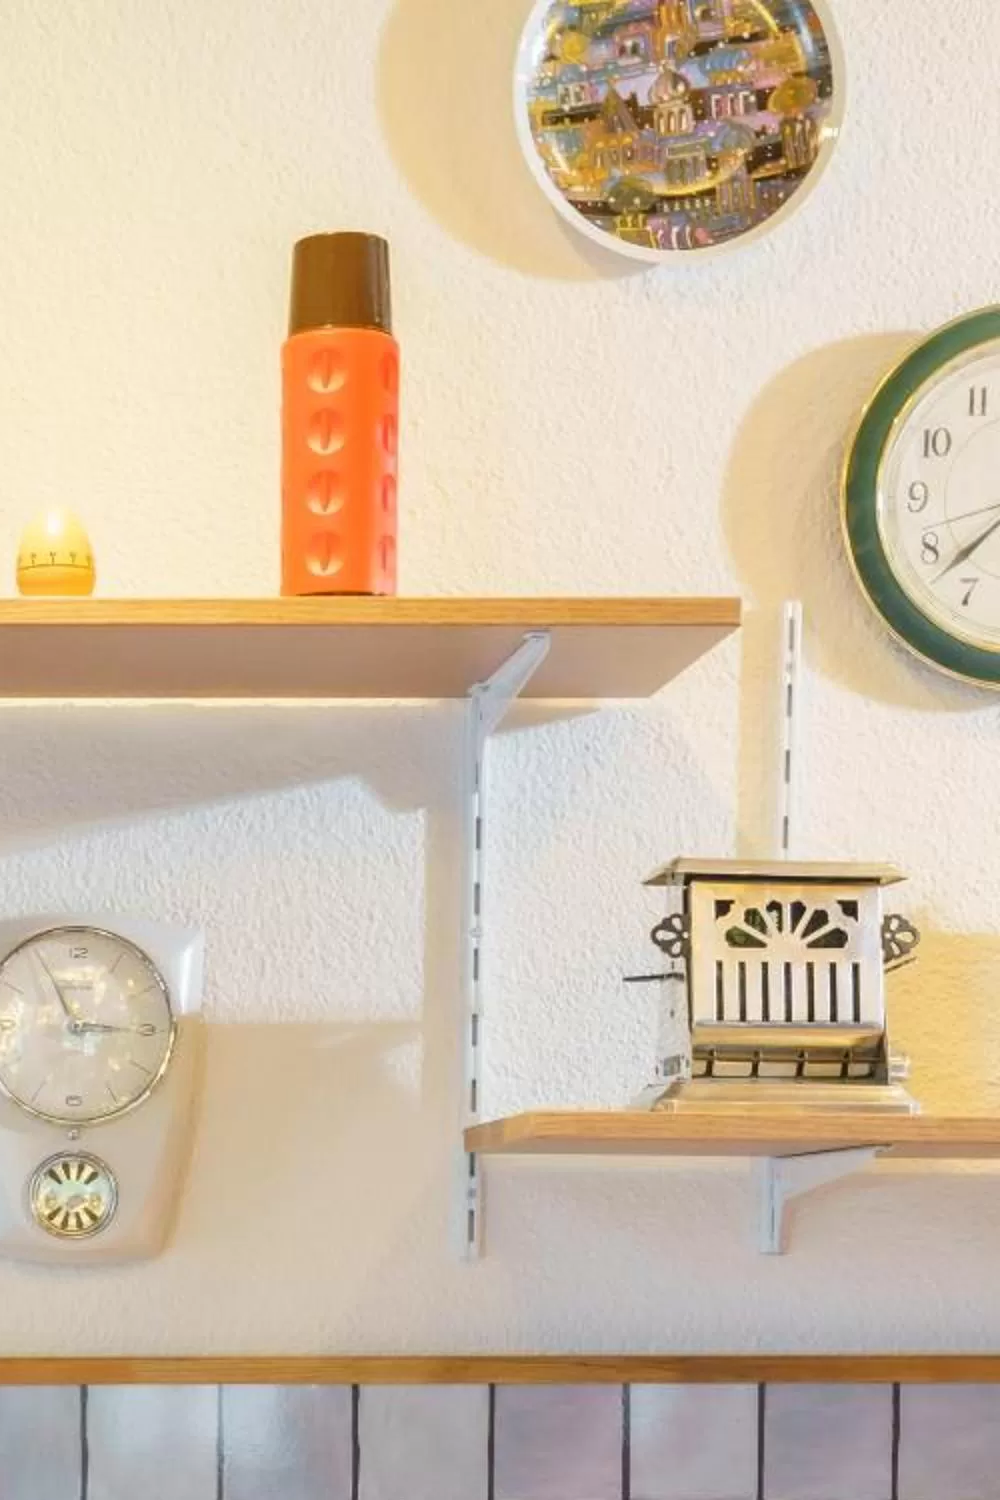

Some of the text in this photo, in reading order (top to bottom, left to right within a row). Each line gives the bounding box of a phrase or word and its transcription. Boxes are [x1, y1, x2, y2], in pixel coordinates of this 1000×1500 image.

[969, 387, 987, 416] 11
[923, 427, 952, 459] 10
[907, 481, 929, 513] 9
[920, 532, 939, 565] 8
[960, 577, 979, 607] 7
[68, 947, 89, 959] 12
